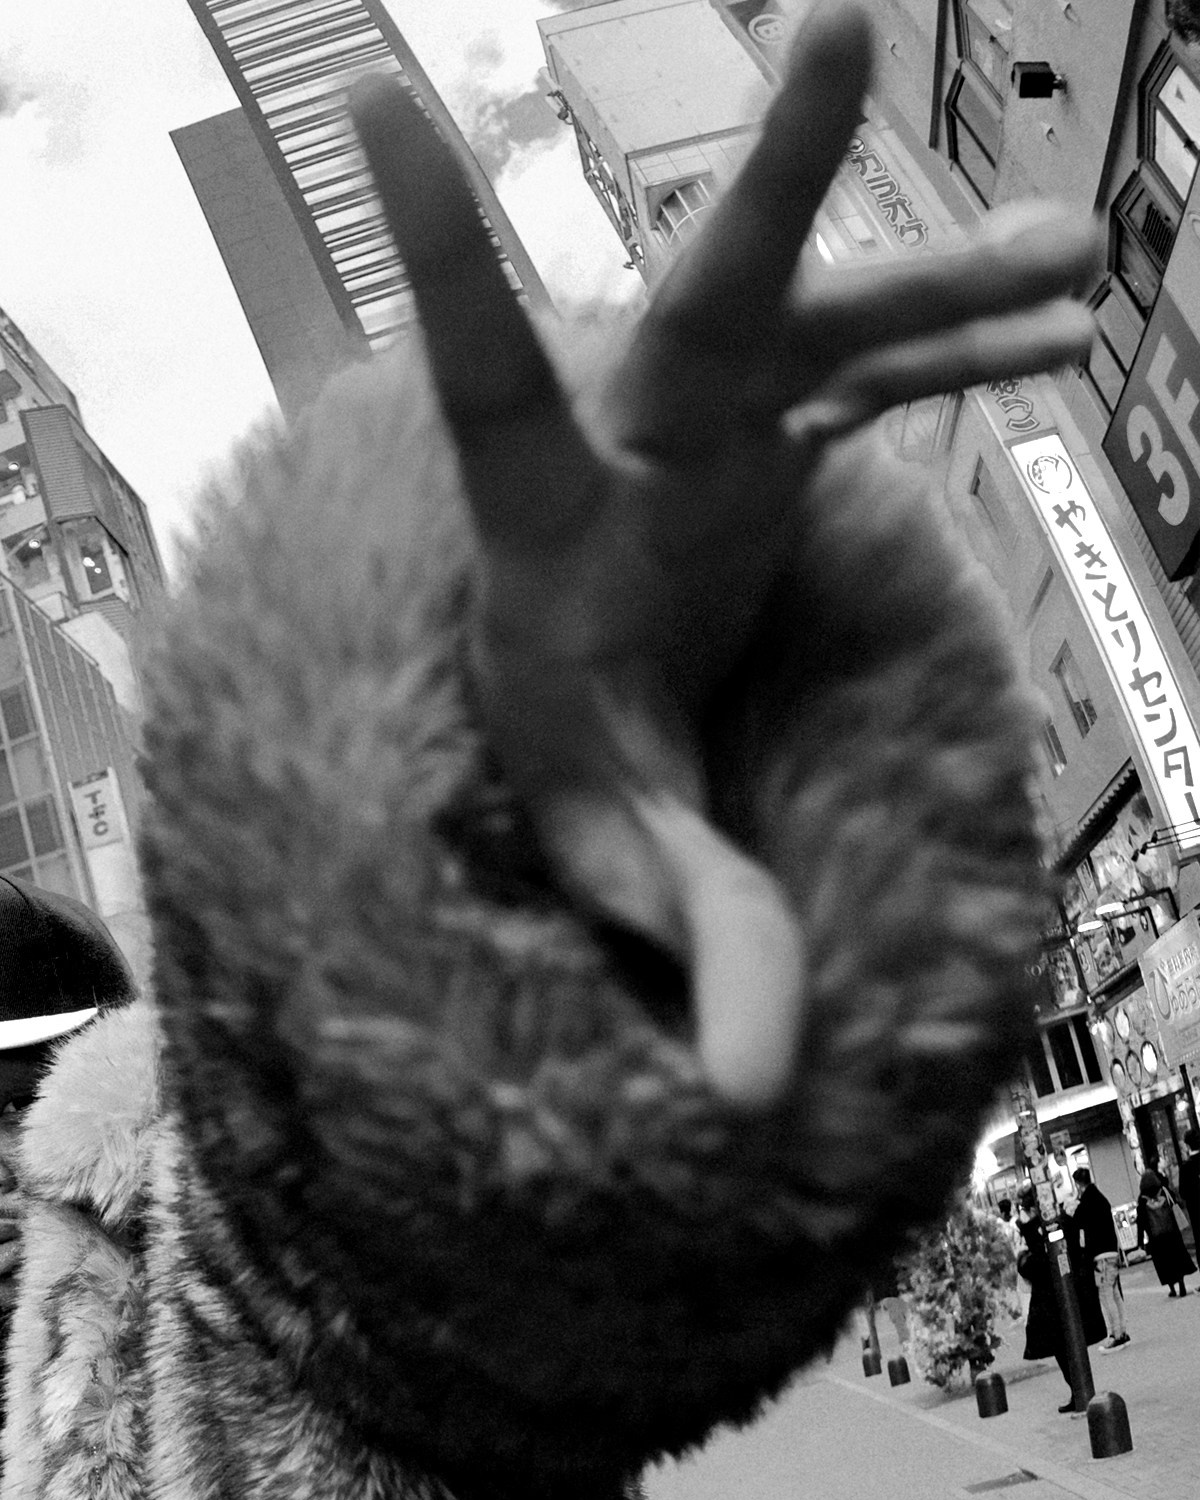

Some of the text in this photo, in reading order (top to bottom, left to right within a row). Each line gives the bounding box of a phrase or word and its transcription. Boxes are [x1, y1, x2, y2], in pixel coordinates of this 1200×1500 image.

[1052, 500, 1200, 826] やきとりセンター
